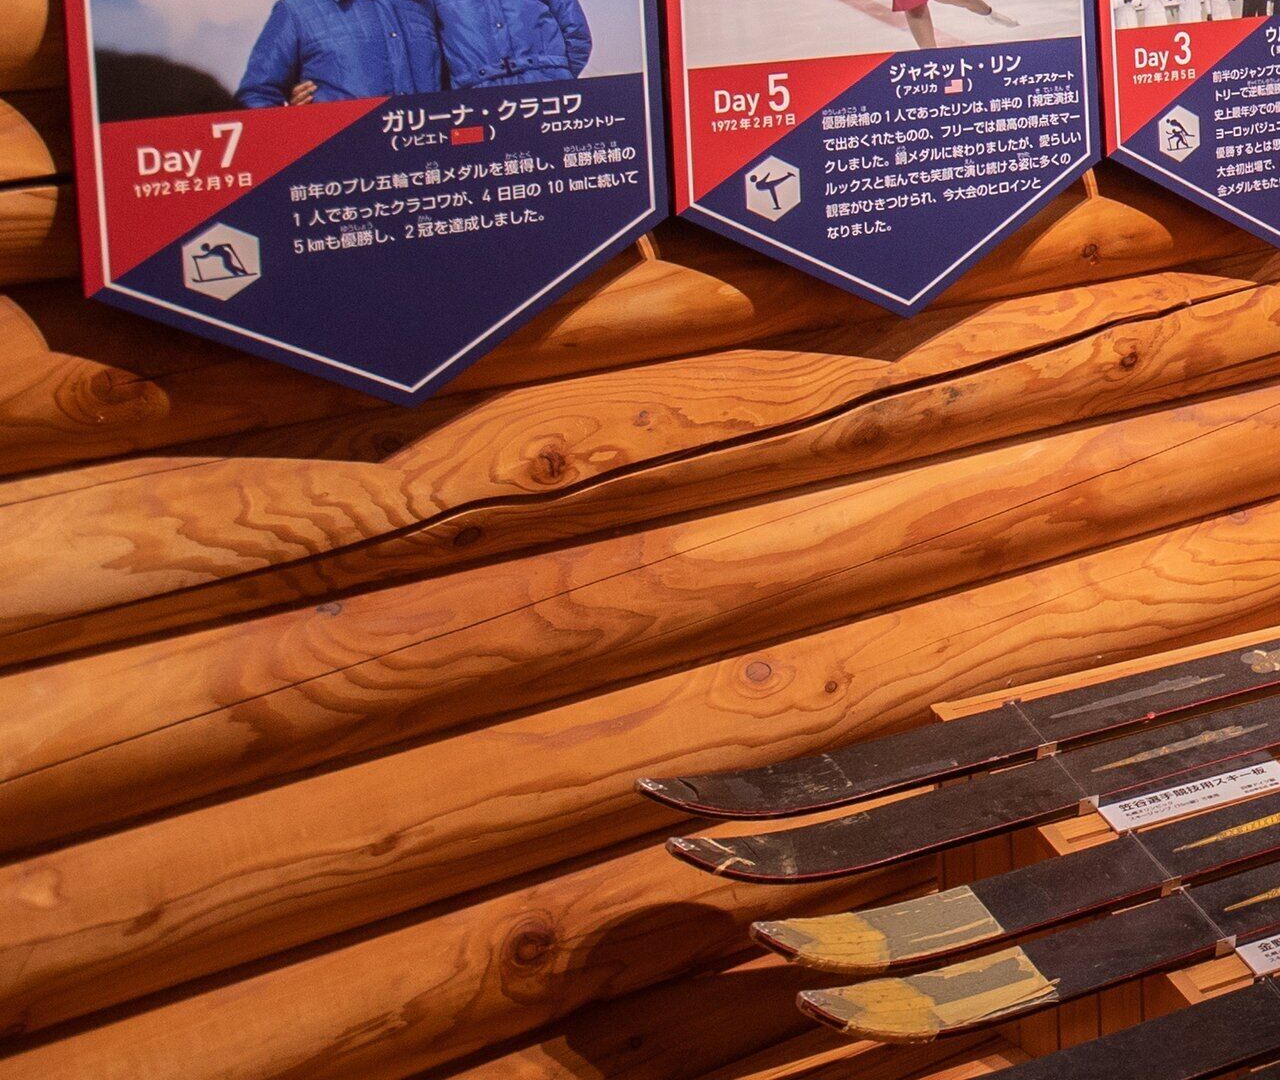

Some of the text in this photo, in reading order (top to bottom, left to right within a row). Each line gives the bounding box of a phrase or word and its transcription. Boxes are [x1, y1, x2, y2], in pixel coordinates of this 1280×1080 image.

[889, 55, 1022, 84] ジャネット・リン
[1134, 31, 1192, 70] Day 3
[714, 72, 791, 116] Day 5
[1003, 71, 1074, 87] フィギュアスケート
[381, 93, 582, 134] ガリーナ・クラコワ
[540, 115, 626, 134] クロスカントリー
[136, 121, 244, 178] Day 7
[290, 146, 636, 202] 前年のプレ五輪で銅メダルを獲得し、優勝候補の
[827, 220, 893, 240] なりました。
